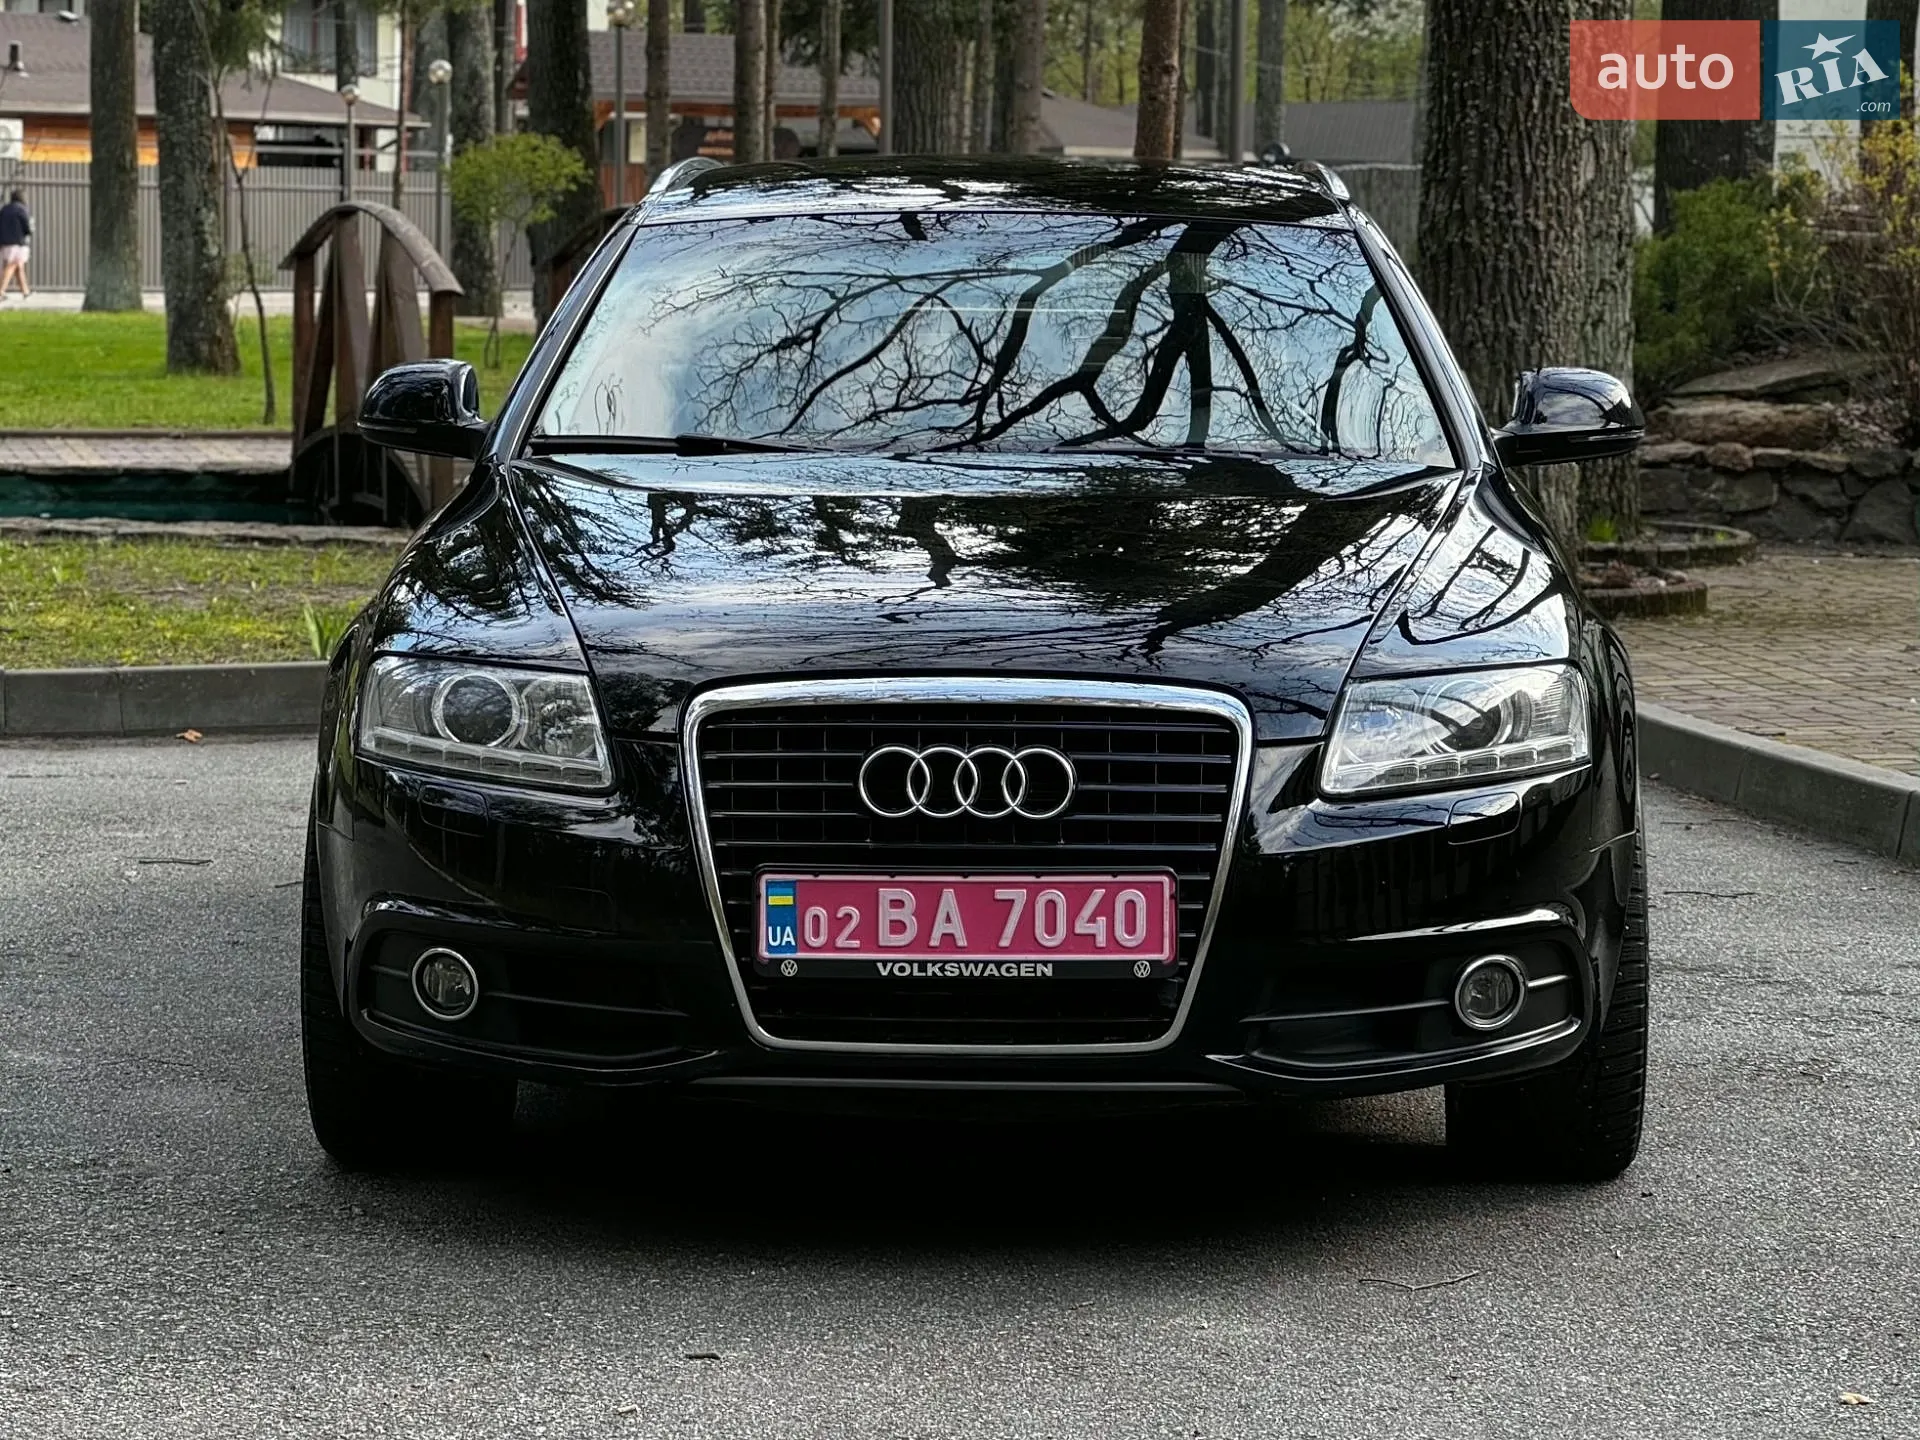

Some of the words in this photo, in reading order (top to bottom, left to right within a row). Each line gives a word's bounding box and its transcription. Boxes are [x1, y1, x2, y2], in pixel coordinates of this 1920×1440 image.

[803, 906, 861, 948] 02
[877, 888, 968, 948] BA
[994, 888, 1147, 948] 7040
[767, 926, 796, 946] UA
[877, 962, 1053, 976] VOLKSWAGEN
